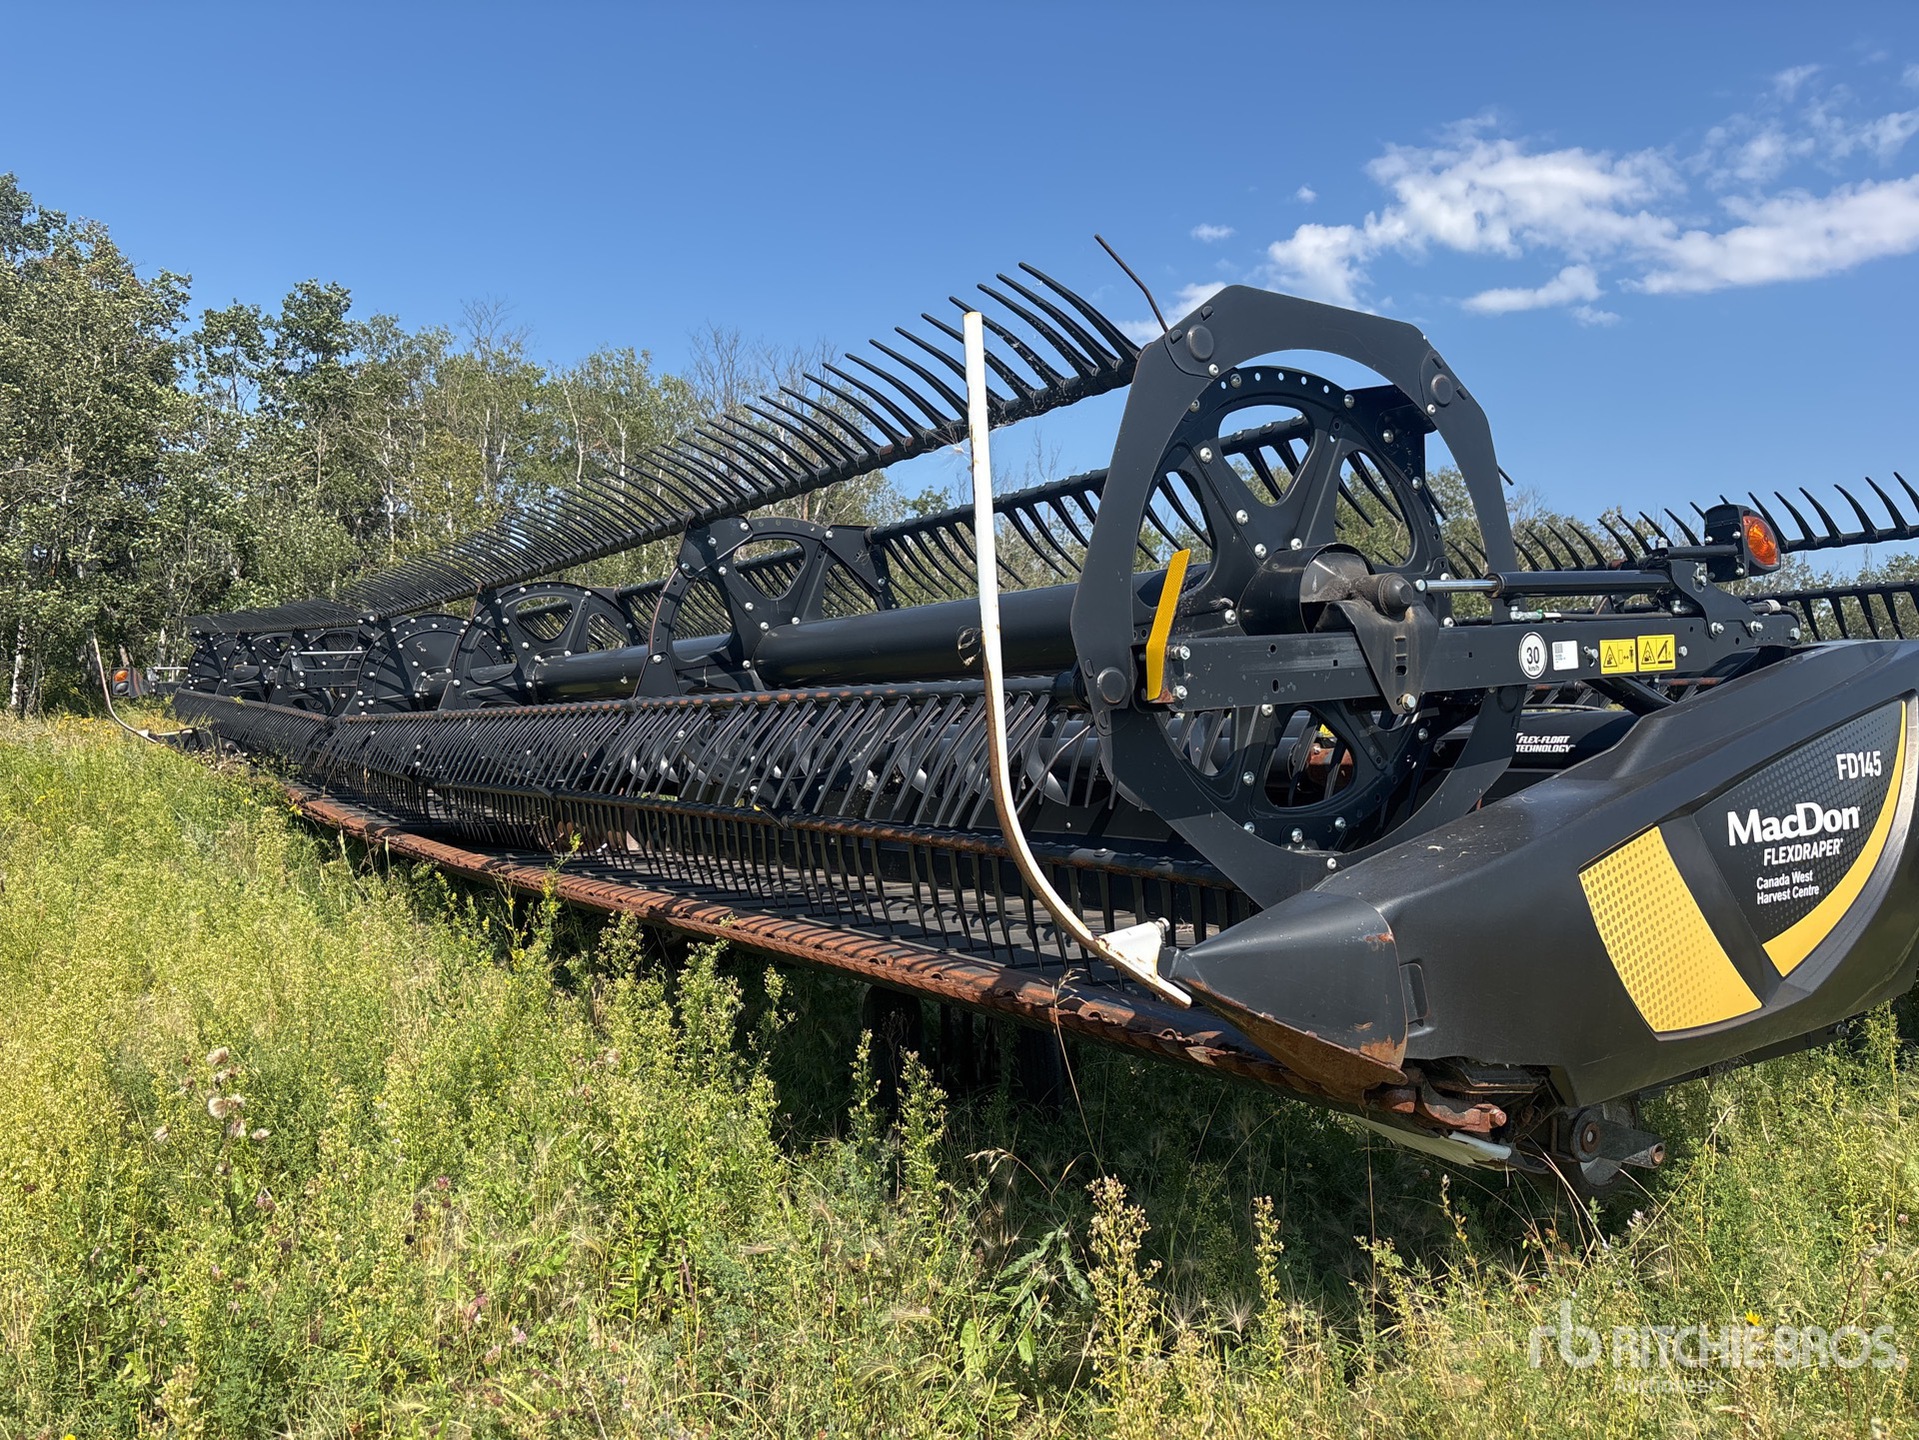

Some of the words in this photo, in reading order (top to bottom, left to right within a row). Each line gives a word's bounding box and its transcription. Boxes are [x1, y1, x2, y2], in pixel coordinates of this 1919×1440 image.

[1526, 646, 1540, 664] 30
[1515, 744, 1571, 753] TECHNOLOGY
[1516, 732, 1570, 744] FLEX-FLOAT
[1836, 751, 1882, 780] FD145
[1727, 802, 1860, 846] MacDon
[1763, 838, 1844, 866] FLEXDRAPER
[1756, 873, 1790, 890] Canada
[1791, 869, 1813, 884] West
[1756, 888, 1791, 905] Harvest
[1792, 884, 1820, 899] Centre
